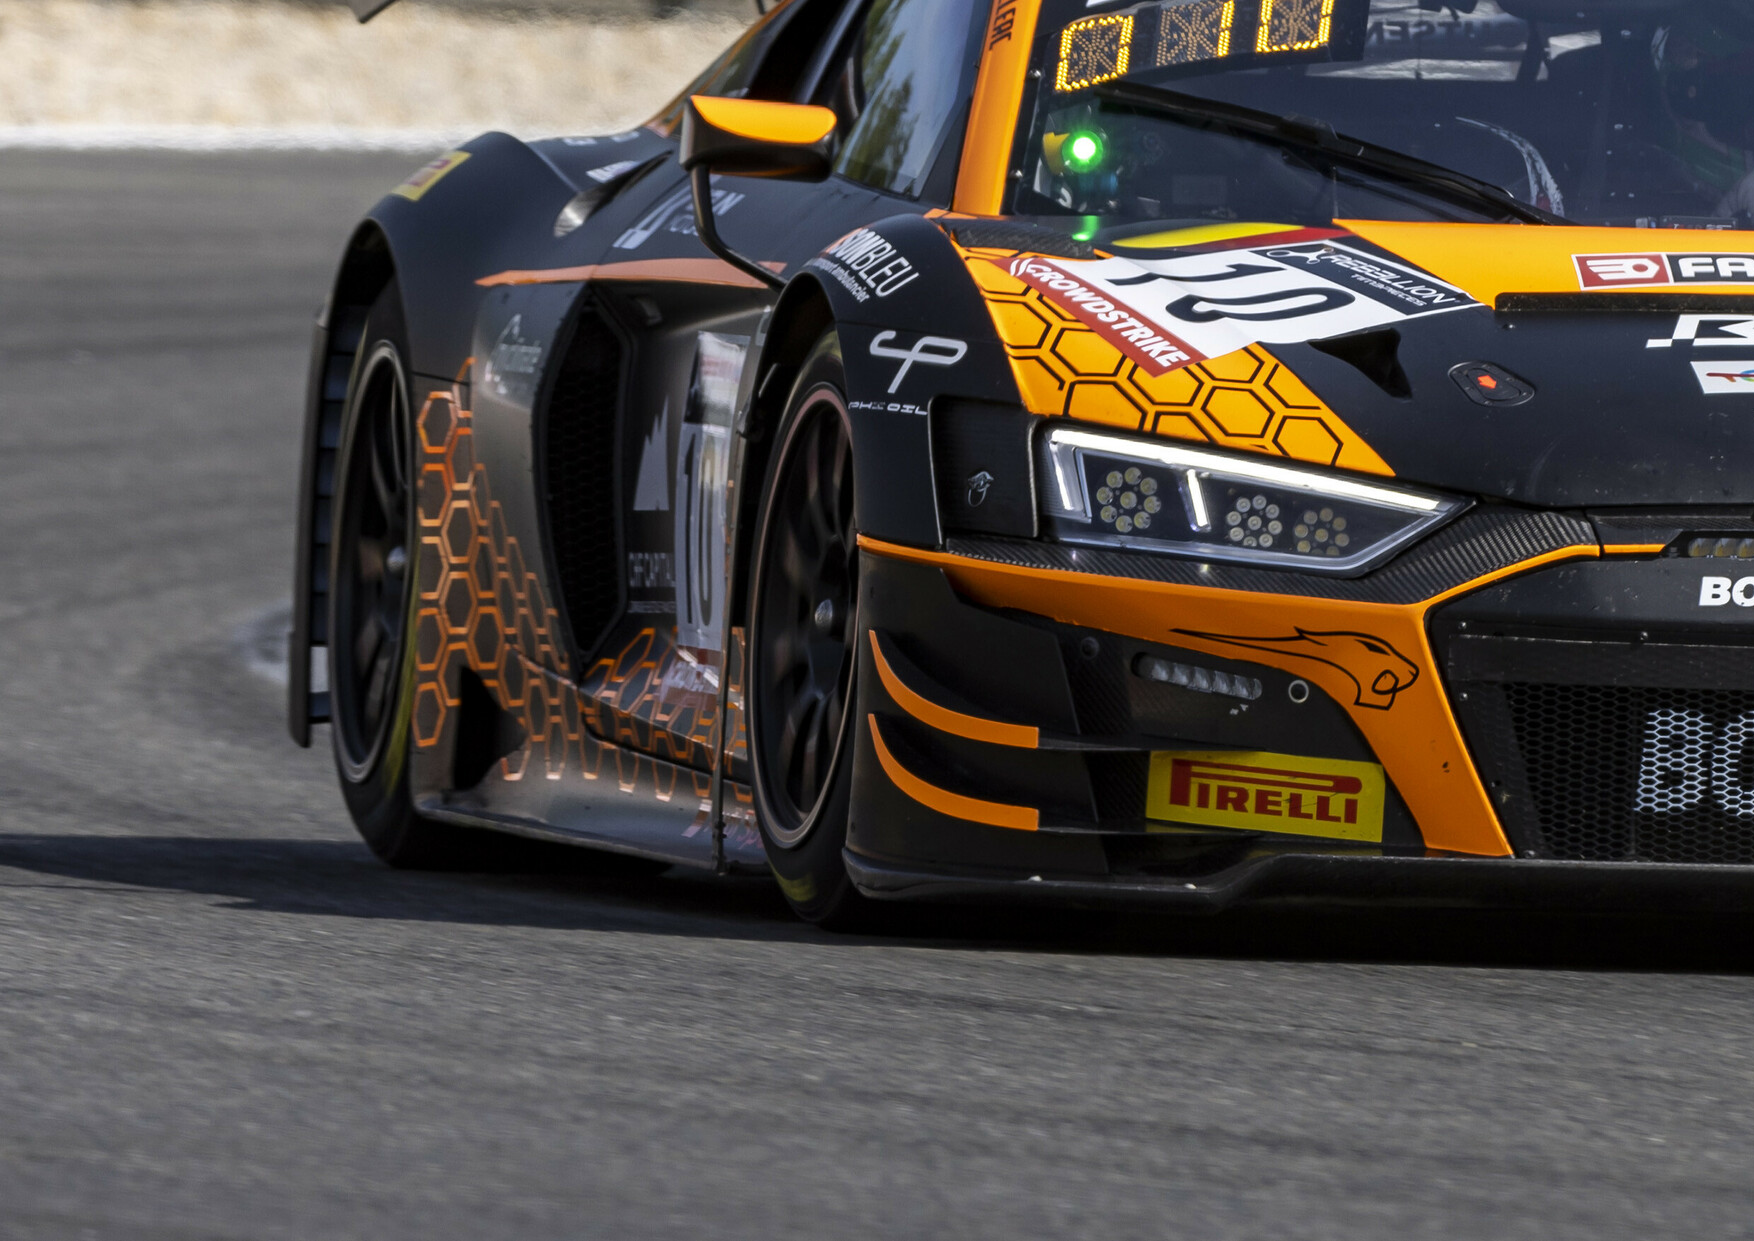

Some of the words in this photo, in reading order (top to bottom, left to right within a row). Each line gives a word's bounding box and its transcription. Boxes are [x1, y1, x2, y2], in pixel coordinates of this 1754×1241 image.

[1104, 263, 1356, 323] 10
[1320, 253, 1455, 304] REBELLION
[1026, 263, 1191, 368] CROWDSTRIKE
[1169, 757, 1363, 825] PIRELLI
